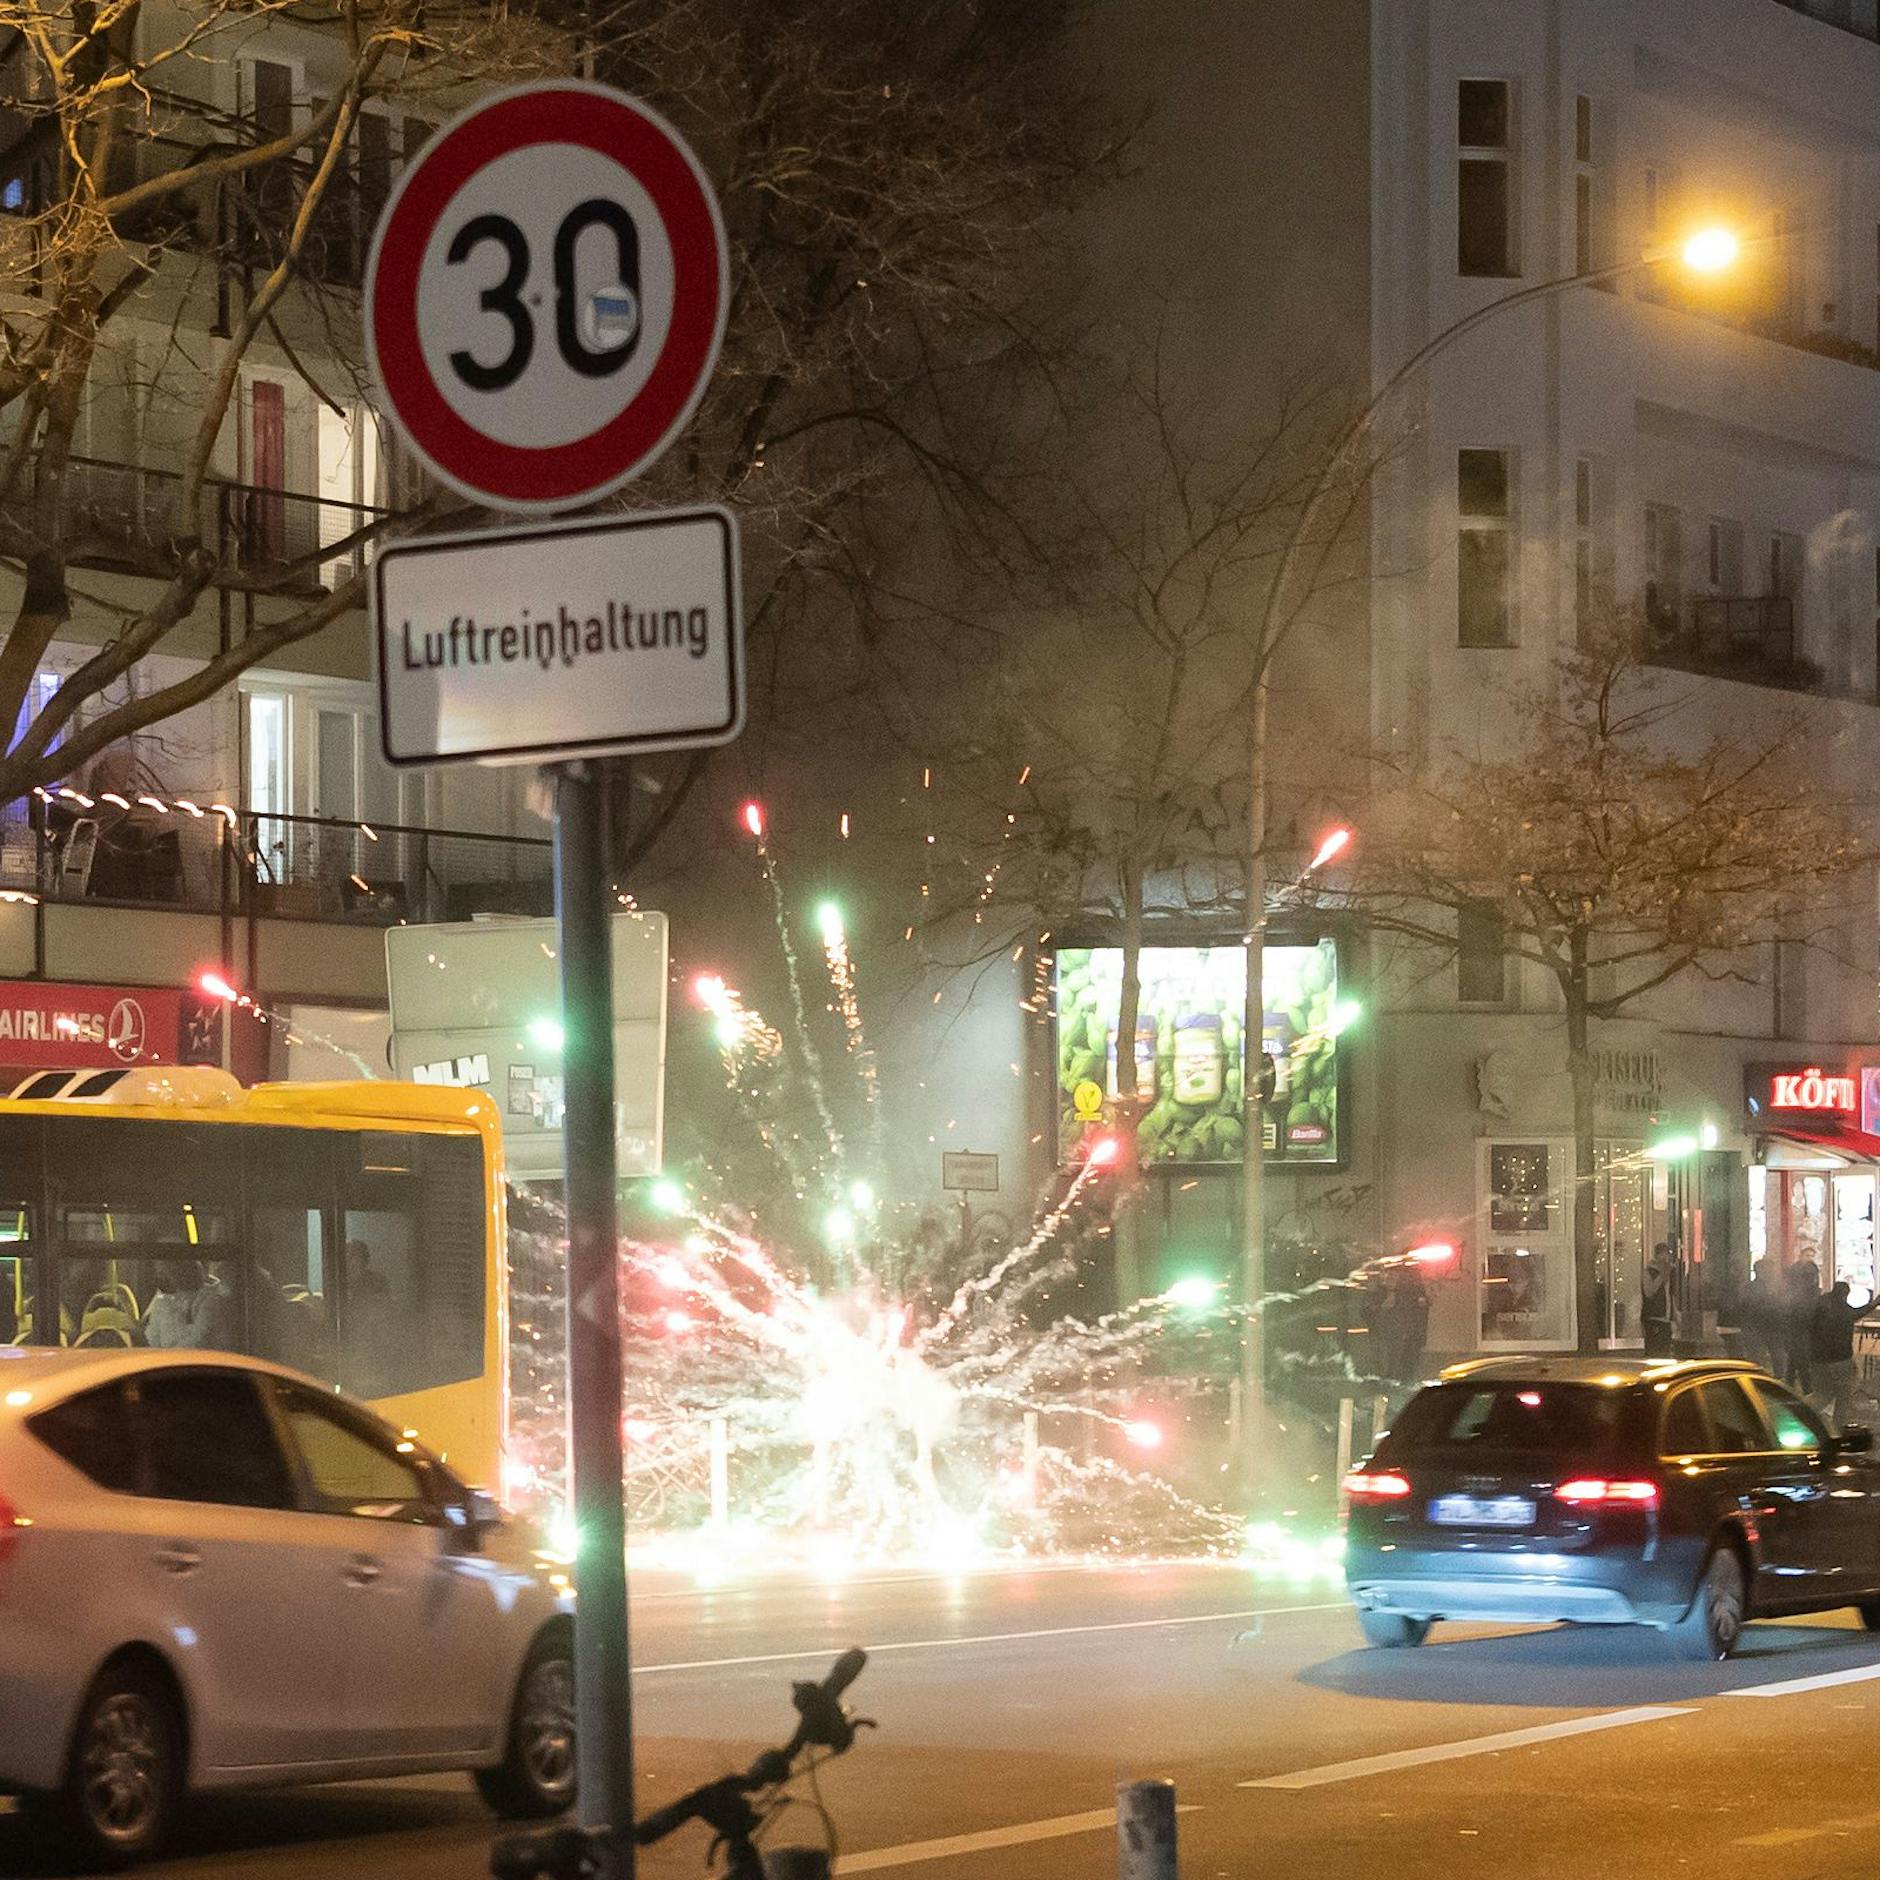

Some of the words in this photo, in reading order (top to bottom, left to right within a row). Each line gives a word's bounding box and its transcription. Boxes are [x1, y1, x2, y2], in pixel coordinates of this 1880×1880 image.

[447, 198, 641, 392] 30
[402, 601, 708, 671] Luftreinhaltung
[0, 1008, 106, 1044] AIRLINES
